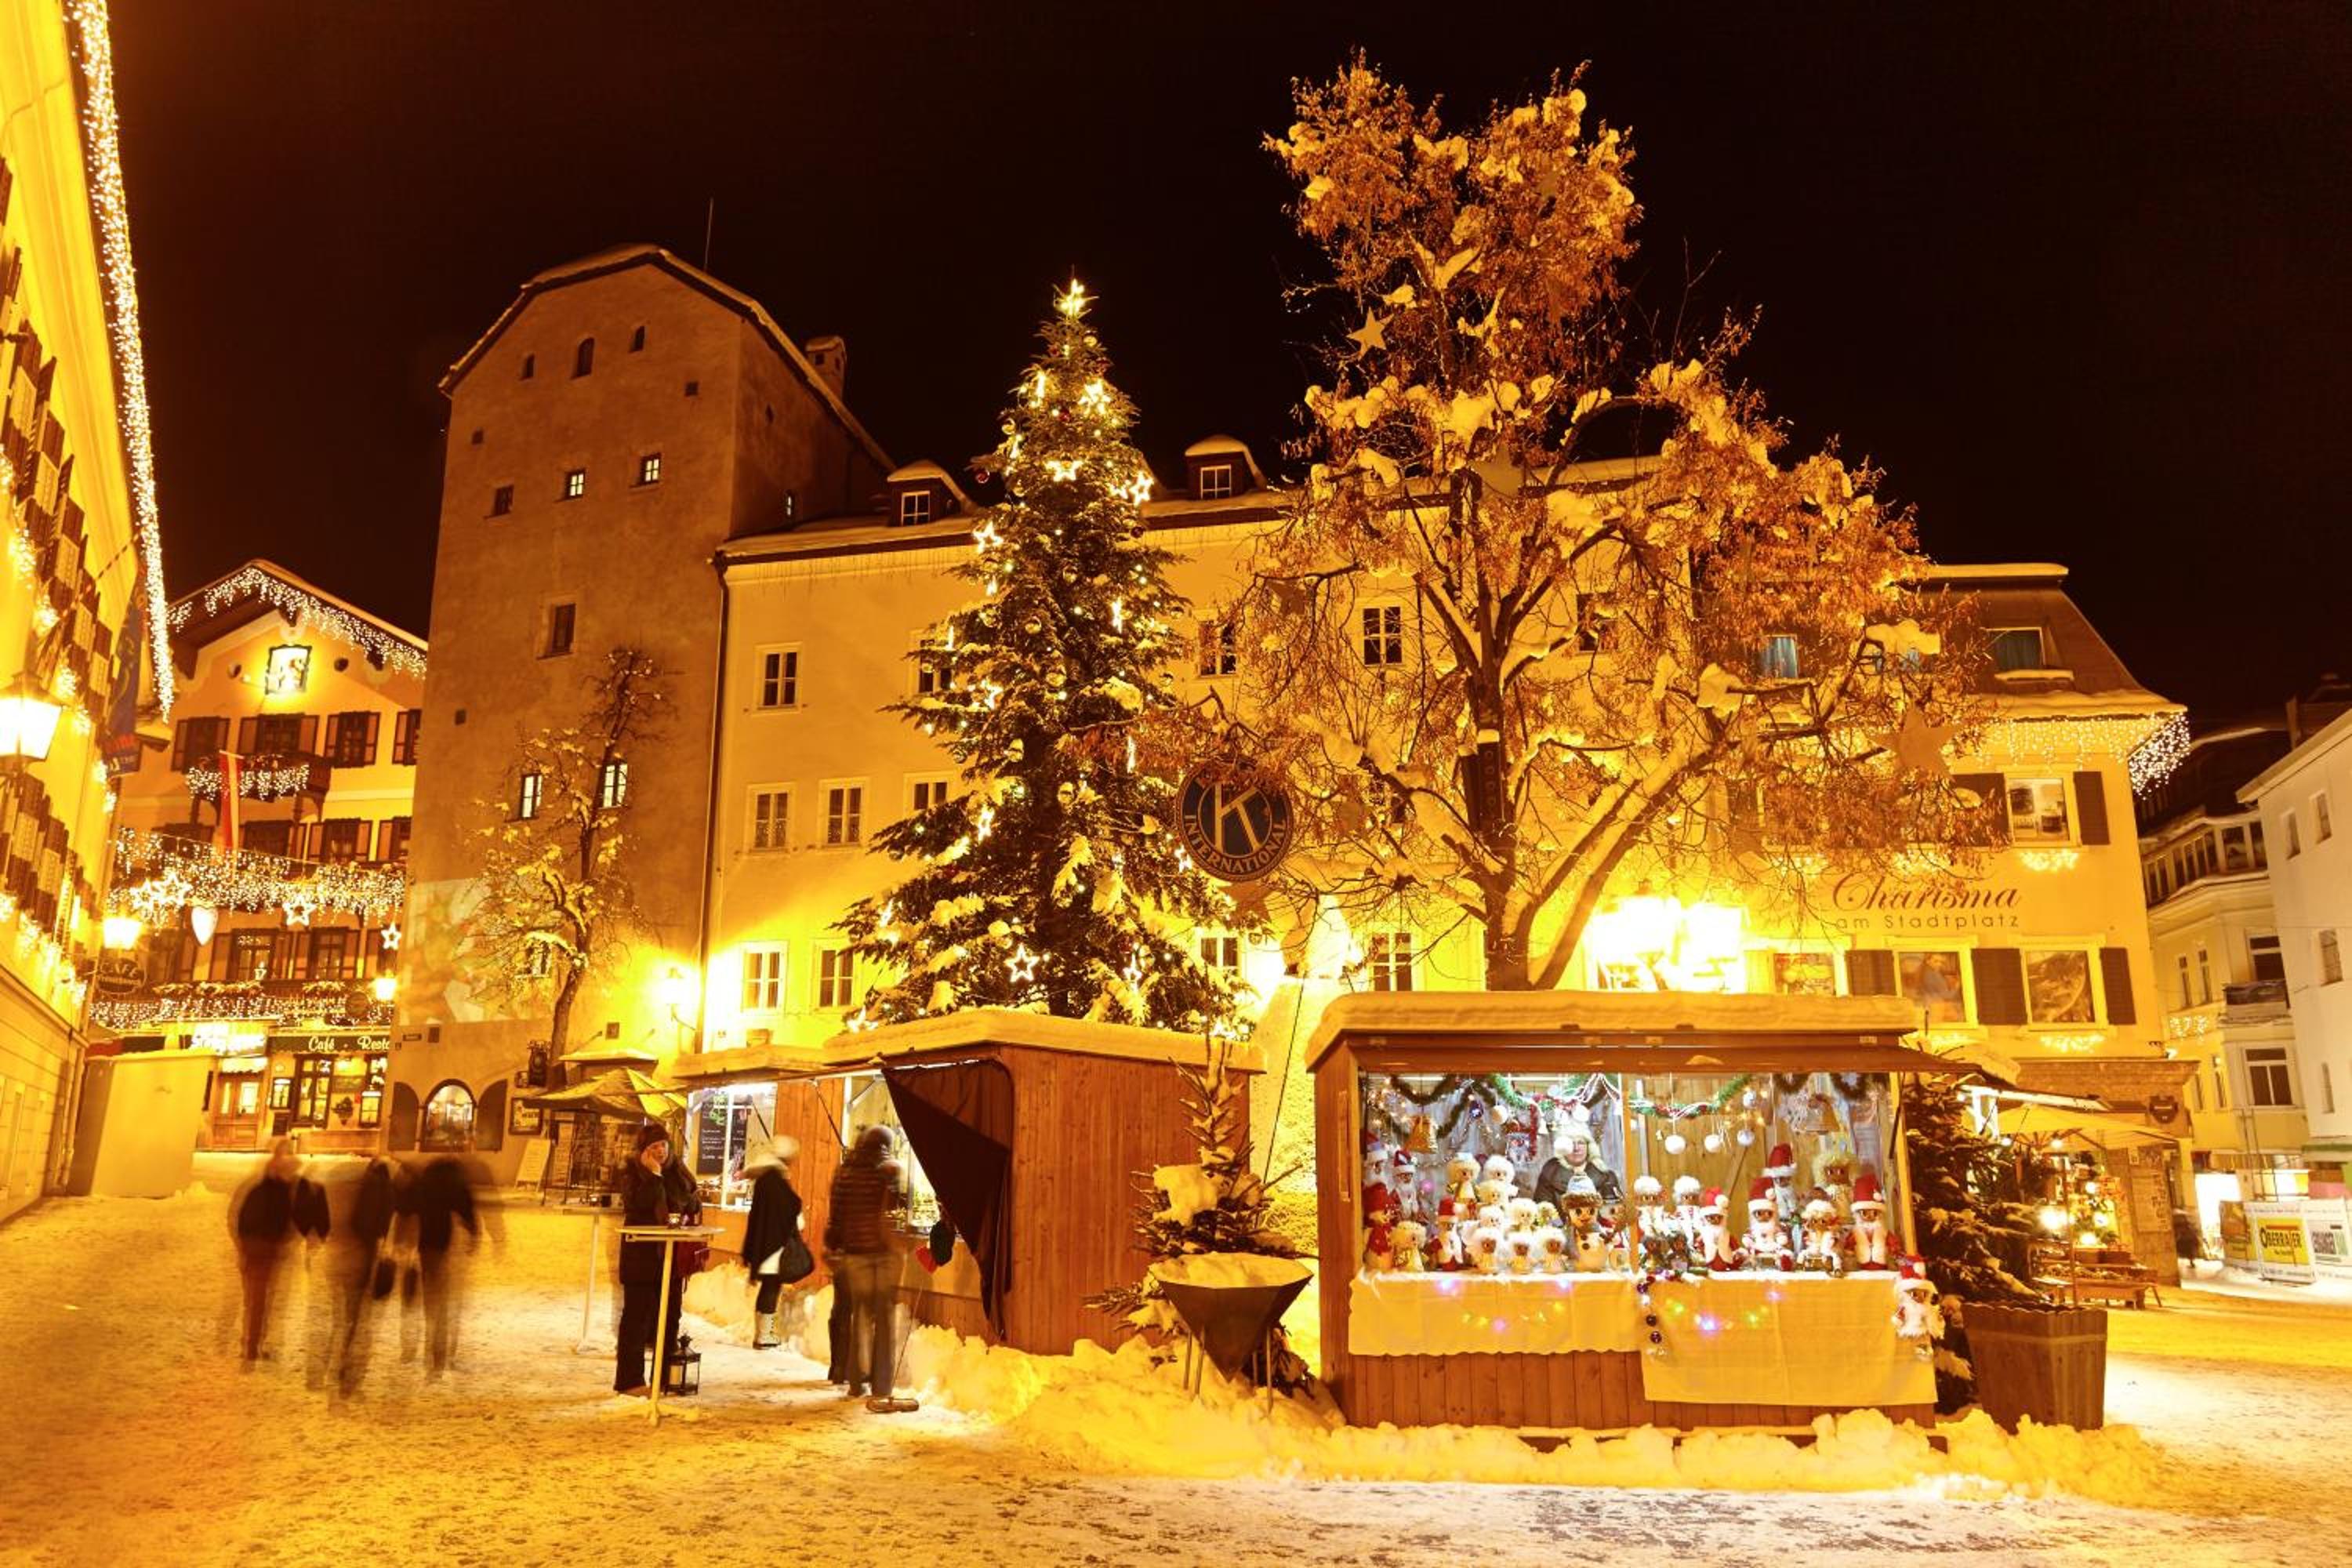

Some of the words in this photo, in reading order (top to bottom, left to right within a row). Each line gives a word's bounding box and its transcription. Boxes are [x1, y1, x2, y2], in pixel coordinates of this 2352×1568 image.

[1214, 782, 1261, 855] K
[1184, 815, 1287, 873] INTERNATIONAL
[1833, 870, 2020, 910] Charisma
[1837, 917, 1870, 929] am
[1885, 914, 2020, 931] Stadtplatz
[308, 1035, 336, 1054] Café
